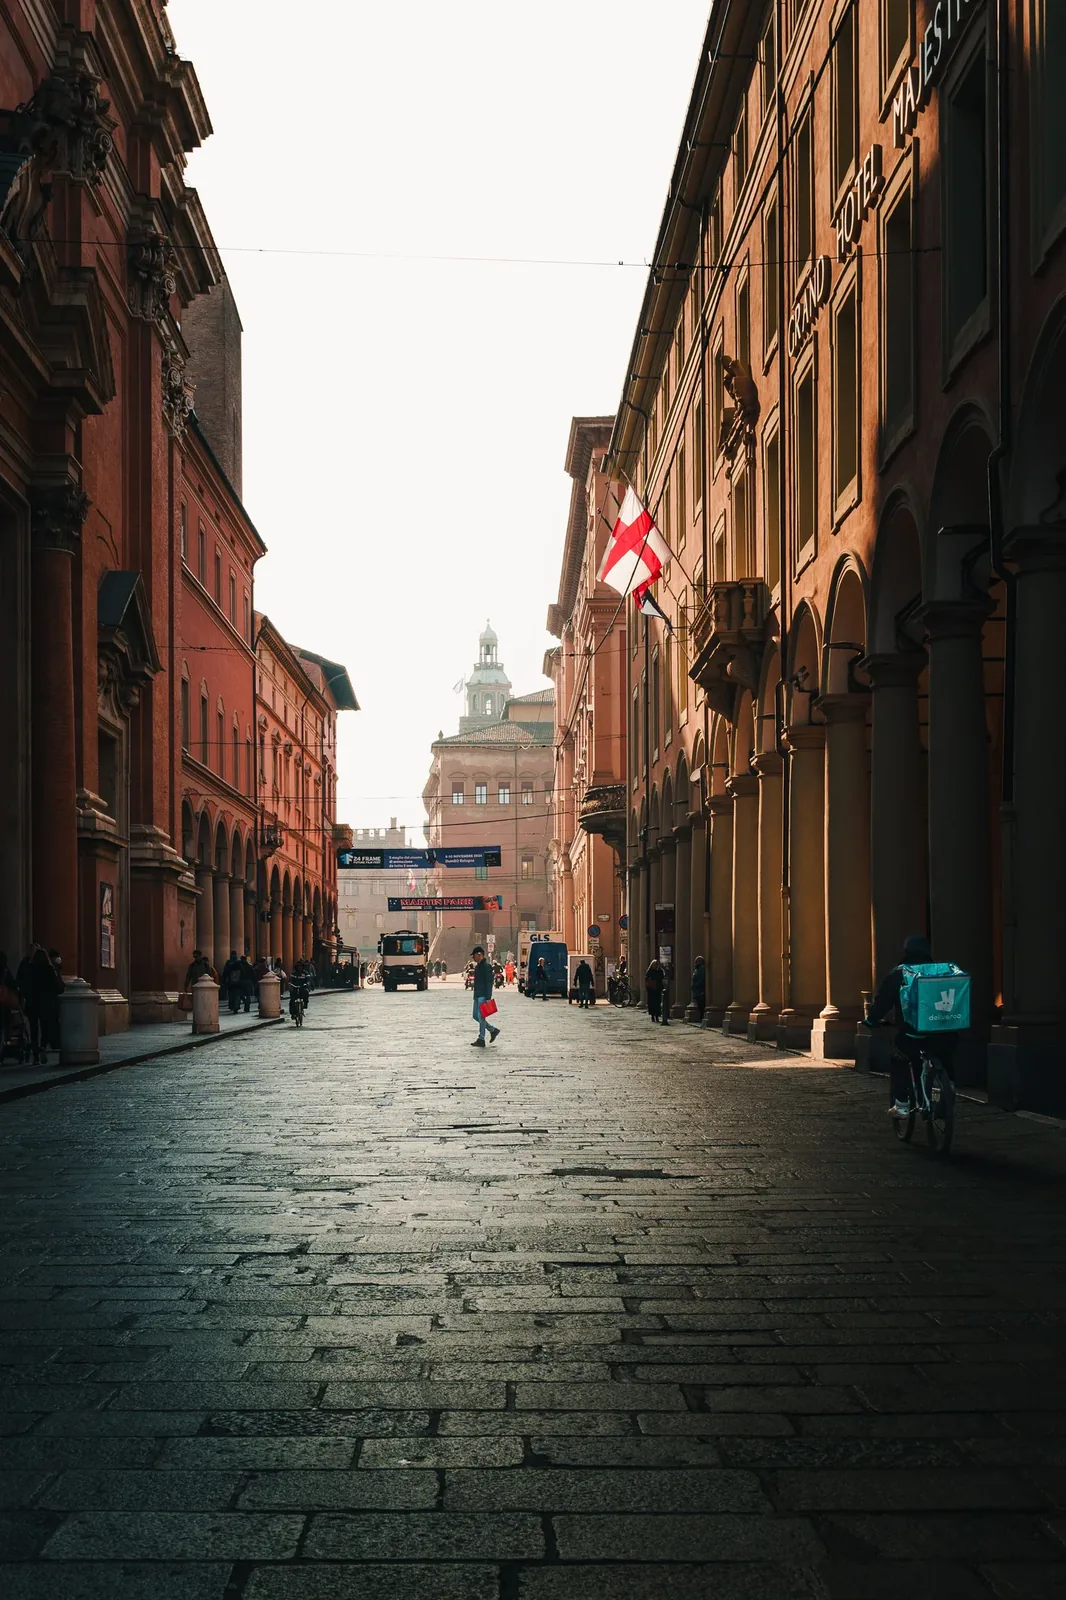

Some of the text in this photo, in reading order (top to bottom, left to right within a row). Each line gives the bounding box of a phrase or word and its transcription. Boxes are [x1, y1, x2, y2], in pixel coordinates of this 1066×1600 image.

[788, 255, 826, 358] GRAND
[836, 144, 879, 263] HOTEL
[400, 898, 443, 906] MARTIN
[530, 934, 550, 942] GLS
